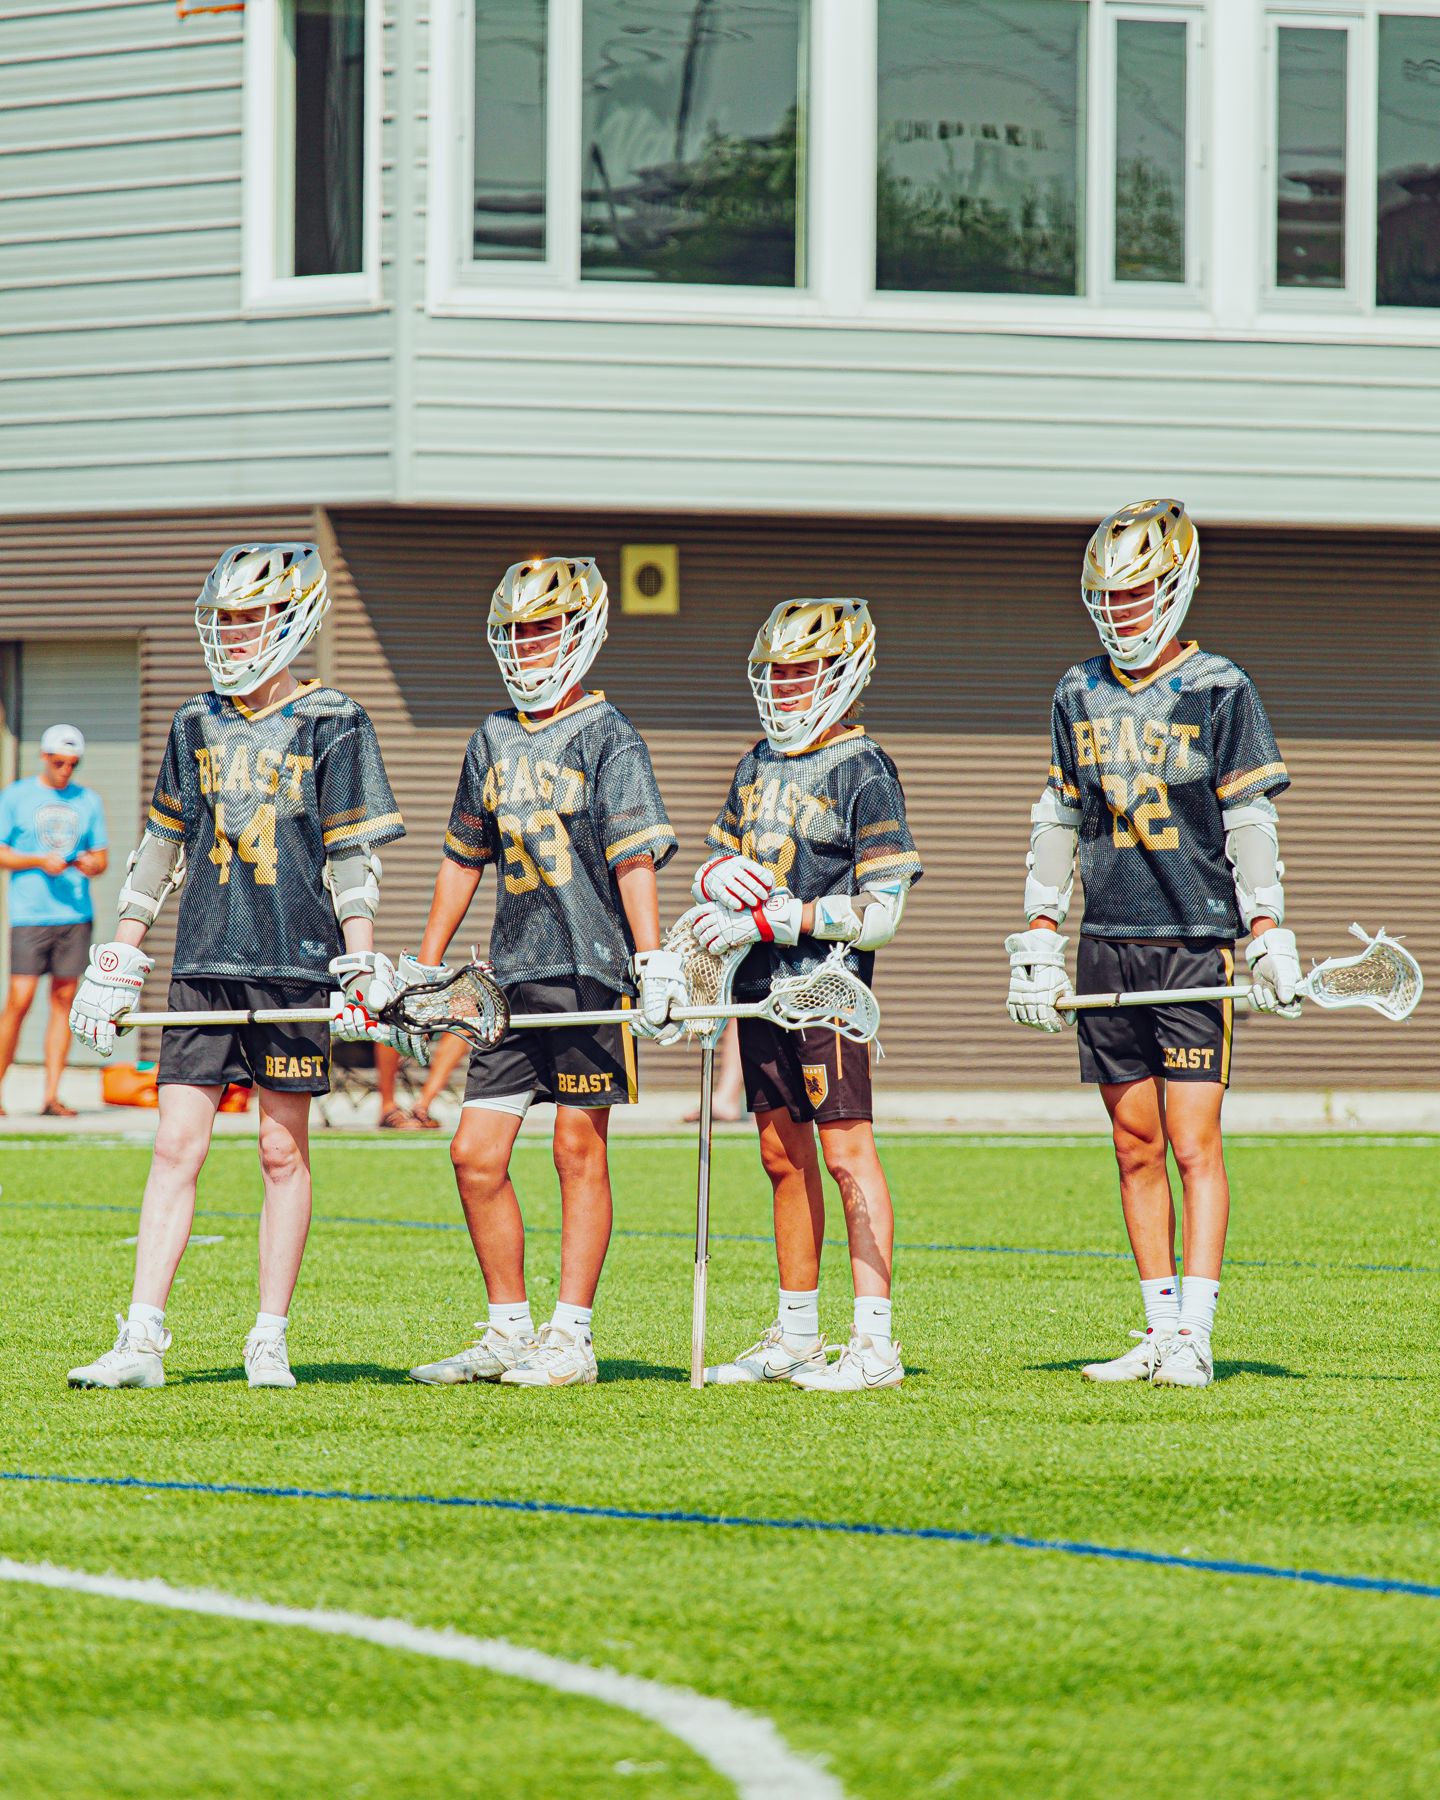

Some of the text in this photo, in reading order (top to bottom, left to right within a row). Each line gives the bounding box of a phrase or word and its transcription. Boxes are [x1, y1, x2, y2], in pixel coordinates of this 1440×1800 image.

[1073, 716, 1200, 768] BEAST
[195, 744, 314, 801] BEAST
[208, 803, 279, 885] 44
[497, 810, 573, 895] 33
[265, 1055, 324, 1078] BEAST
[557, 1072, 613, 1093] BEAST
